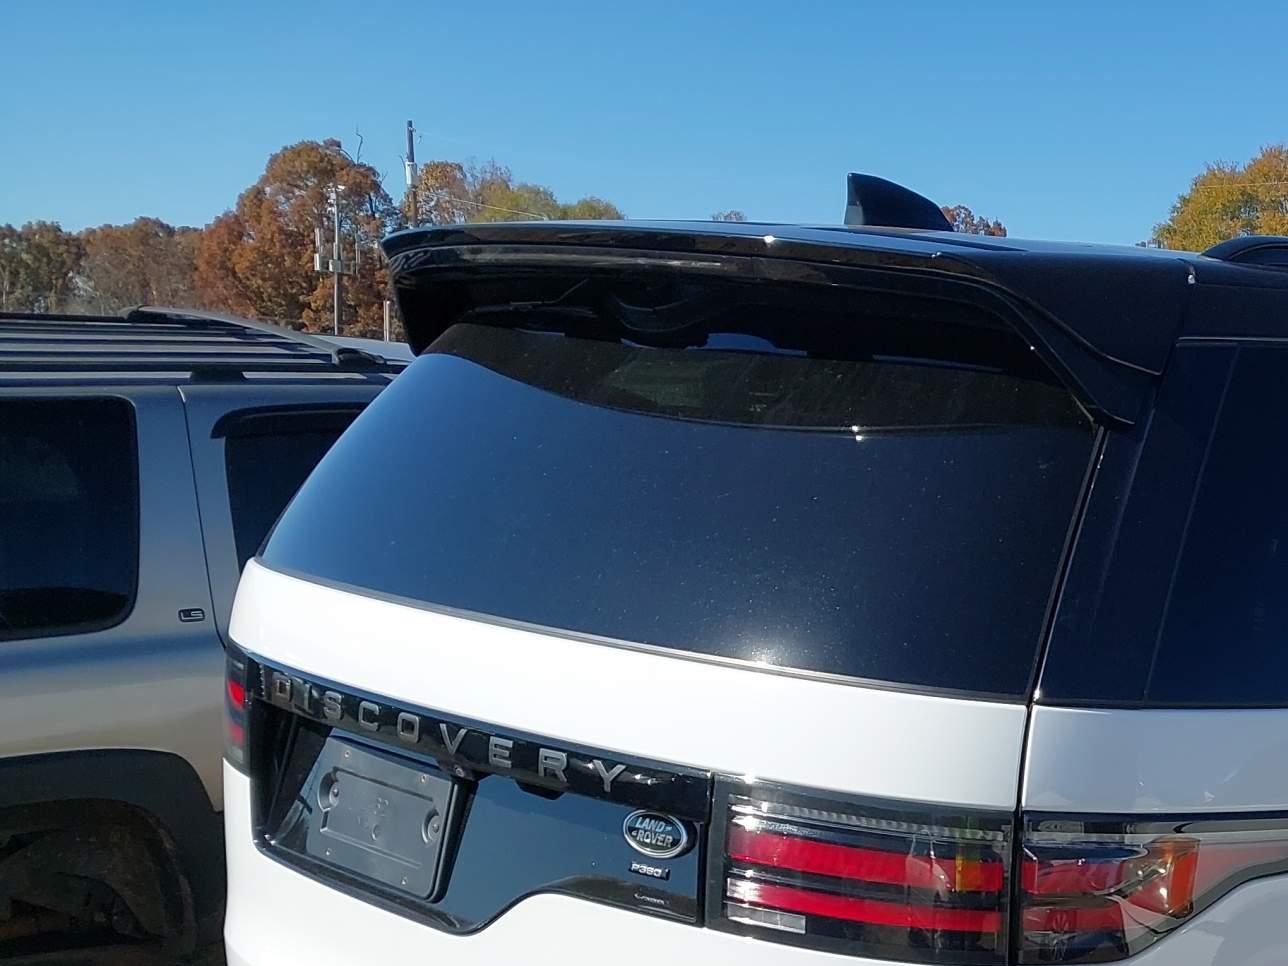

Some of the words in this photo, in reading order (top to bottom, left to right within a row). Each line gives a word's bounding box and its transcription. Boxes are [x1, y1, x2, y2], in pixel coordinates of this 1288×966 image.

[180, 610, 204, 620] LS
[272, 671, 627, 793] DISCOVERY
[635, 816, 666, 833] LAND
[636, 829, 673, 848] ROVER
